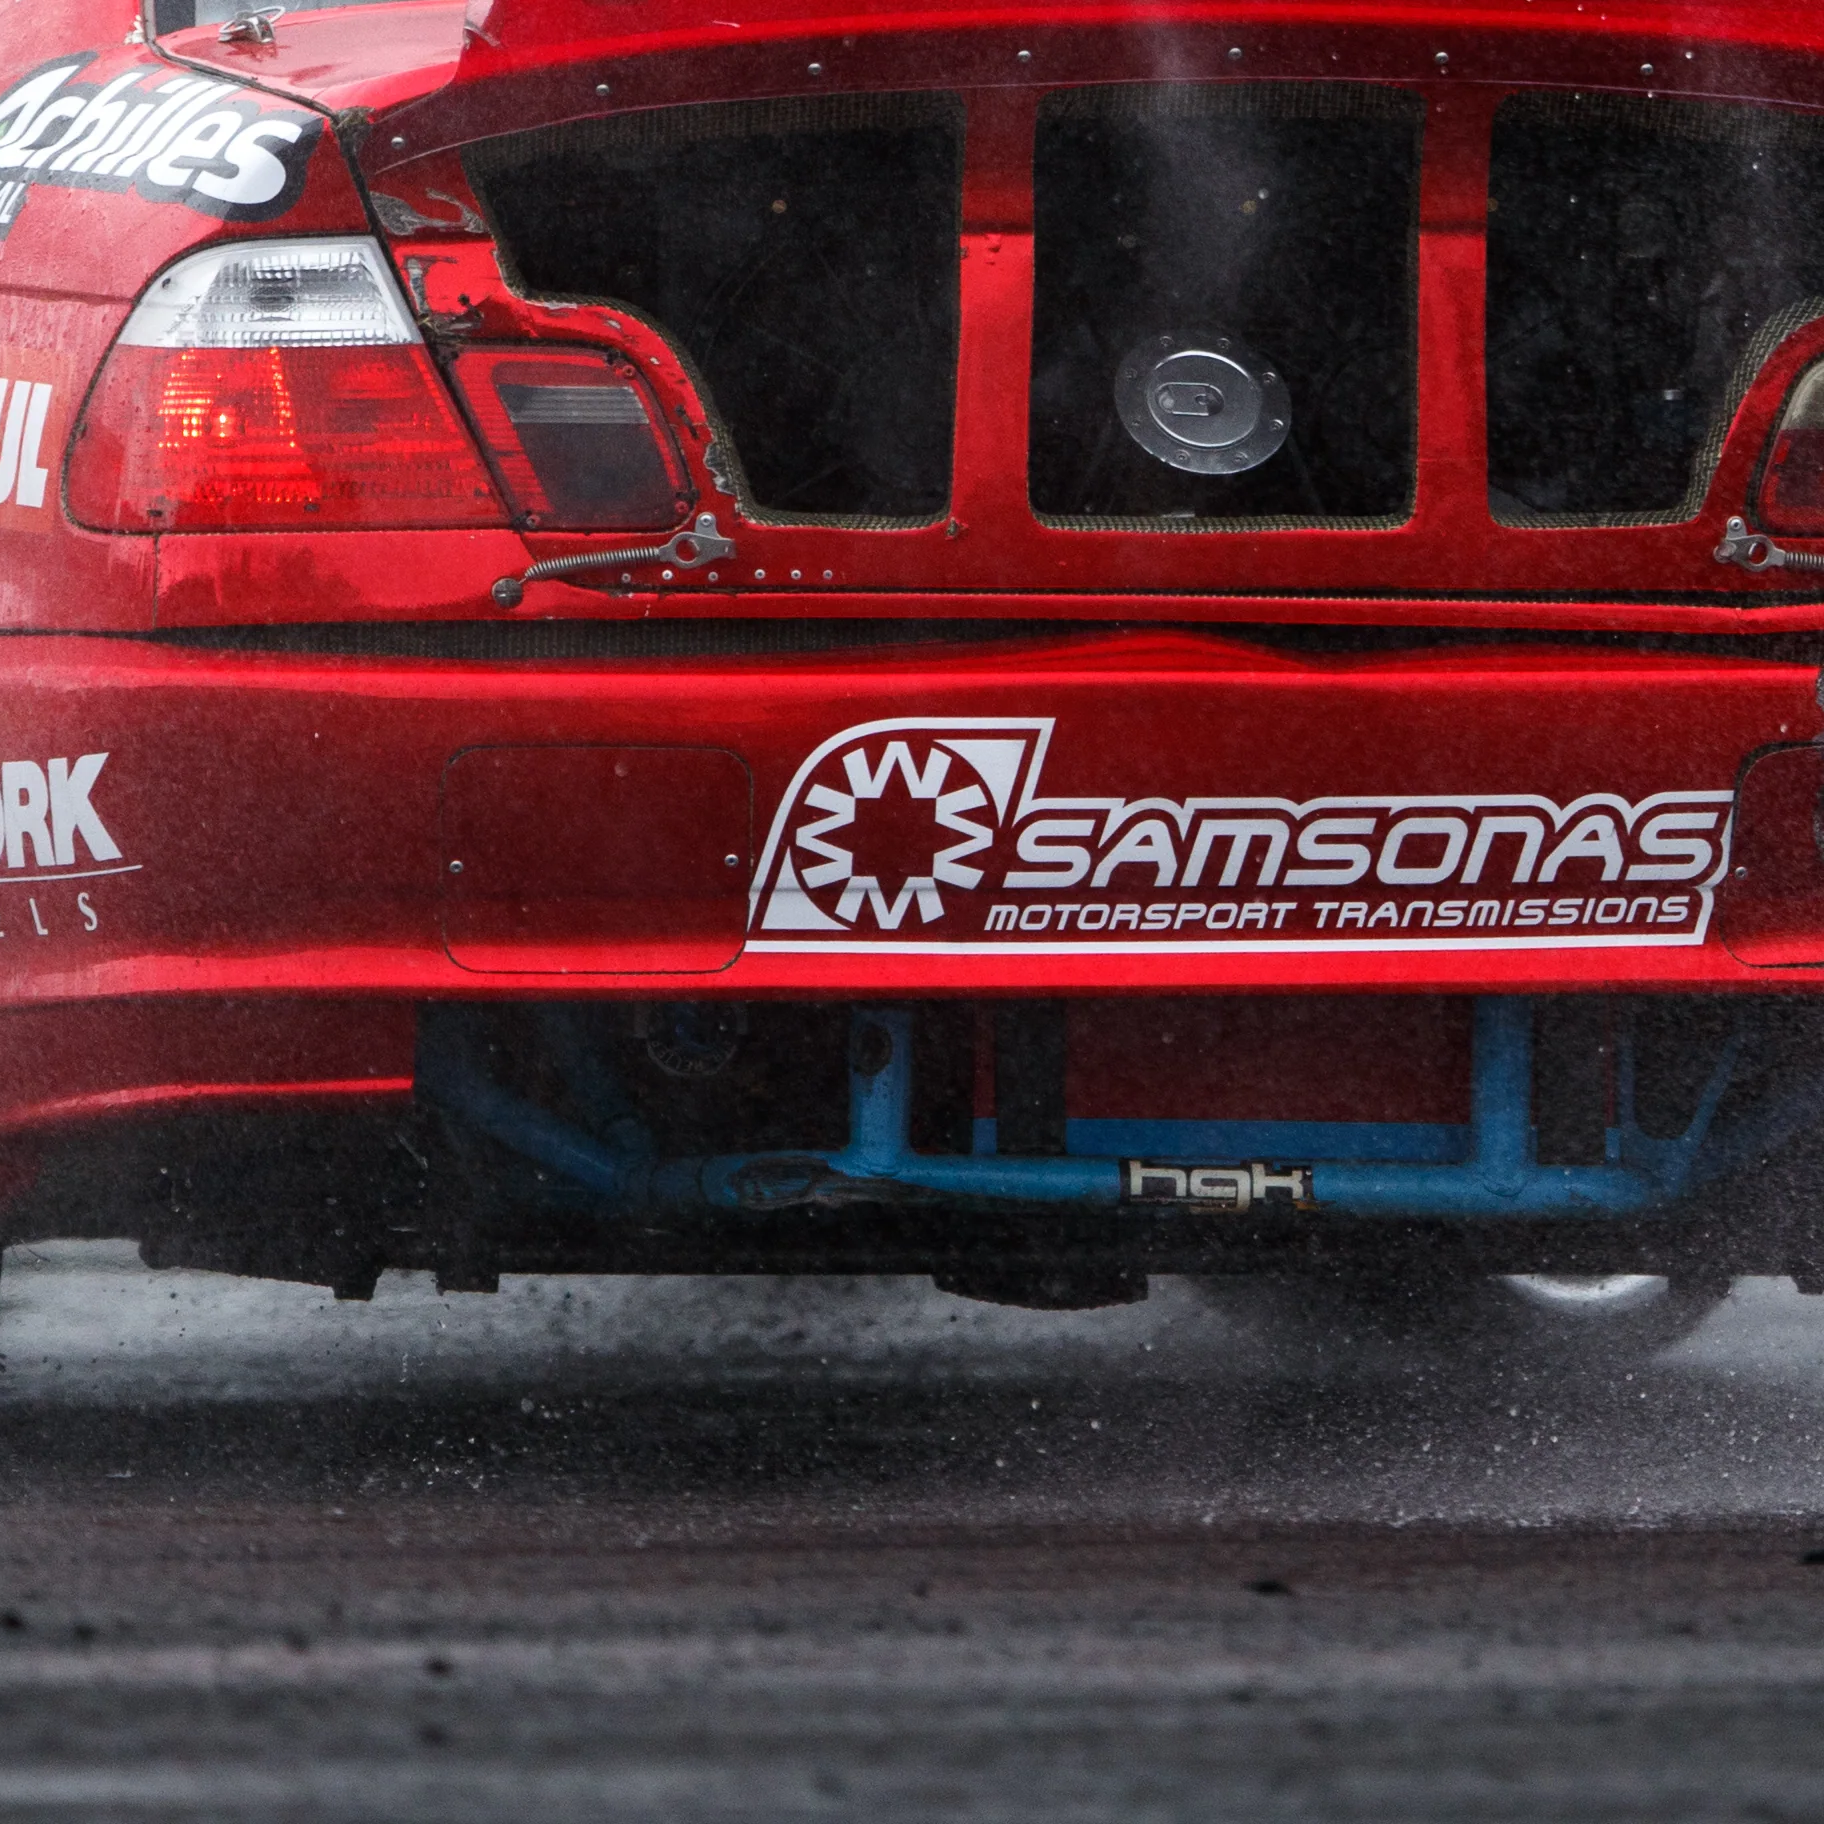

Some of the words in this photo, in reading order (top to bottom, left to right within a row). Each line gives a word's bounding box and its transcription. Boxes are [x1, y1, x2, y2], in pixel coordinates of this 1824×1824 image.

[1002, 812, 1720, 889] SAMSONAS
[983, 901, 1297, 931] MOTORSPORT
[1313, 896, 1690, 929] TRANSMISSIONS
[1128, 1159, 1304, 1213] hgk
